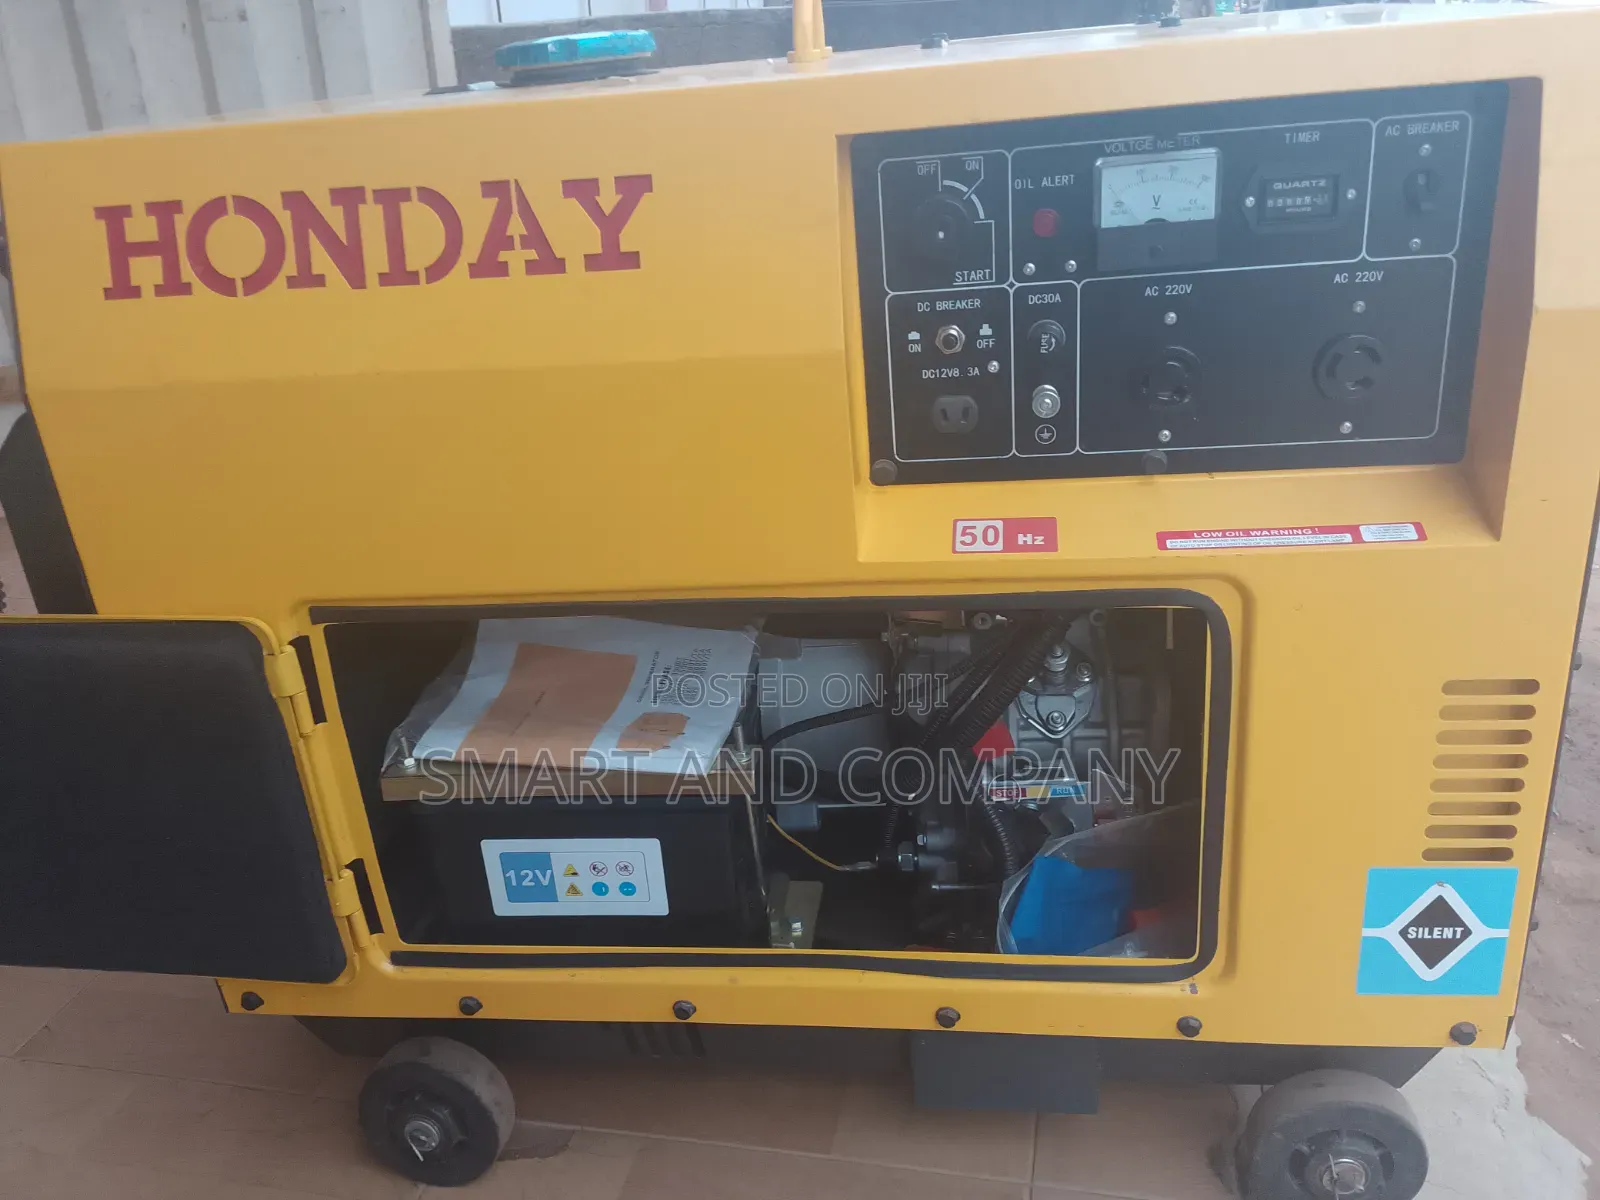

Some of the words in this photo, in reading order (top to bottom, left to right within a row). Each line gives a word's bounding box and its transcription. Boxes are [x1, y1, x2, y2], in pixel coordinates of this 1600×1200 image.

[1385, 125, 1400, 137] AC
[1407, 121, 1459, 134] BREAKER
[1284, 131, 1320, 144] TIMER
[1104, 140, 1153, 154] VOLTGE
[917, 164, 937, 176] OFF
[965, 161, 979, 171] ON
[1014, 178, 1034, 189] OIL
[1041, 175, 1075, 187] ALERT
[1273, 180, 1326, 190] QUARTZ
[94, 174, 653, 300] HONDAY
[955, 269, 991, 282] START
[1334, 273, 1349, 284] AC
[1355, 271, 1384, 283] 220V
[1145, 286, 1159, 296] AC
[1165, 284, 1193, 295] 220V
[917, 302, 930, 312] DC
[936, 299, 981, 311] BREAKER
[1028, 294, 1061, 304] DC30A
[908, 344, 921, 353] ON
[976, 338, 995, 349] OFF
[1040, 333, 1050, 353] FUSE
[959, 525, 1000, 546] 50
[1017, 533, 1045, 545] Hz
[1249, 528, 1312, 536] WARNING
[505, 869, 552, 887] 12V
[1407, 926, 1464, 939] SILENT
